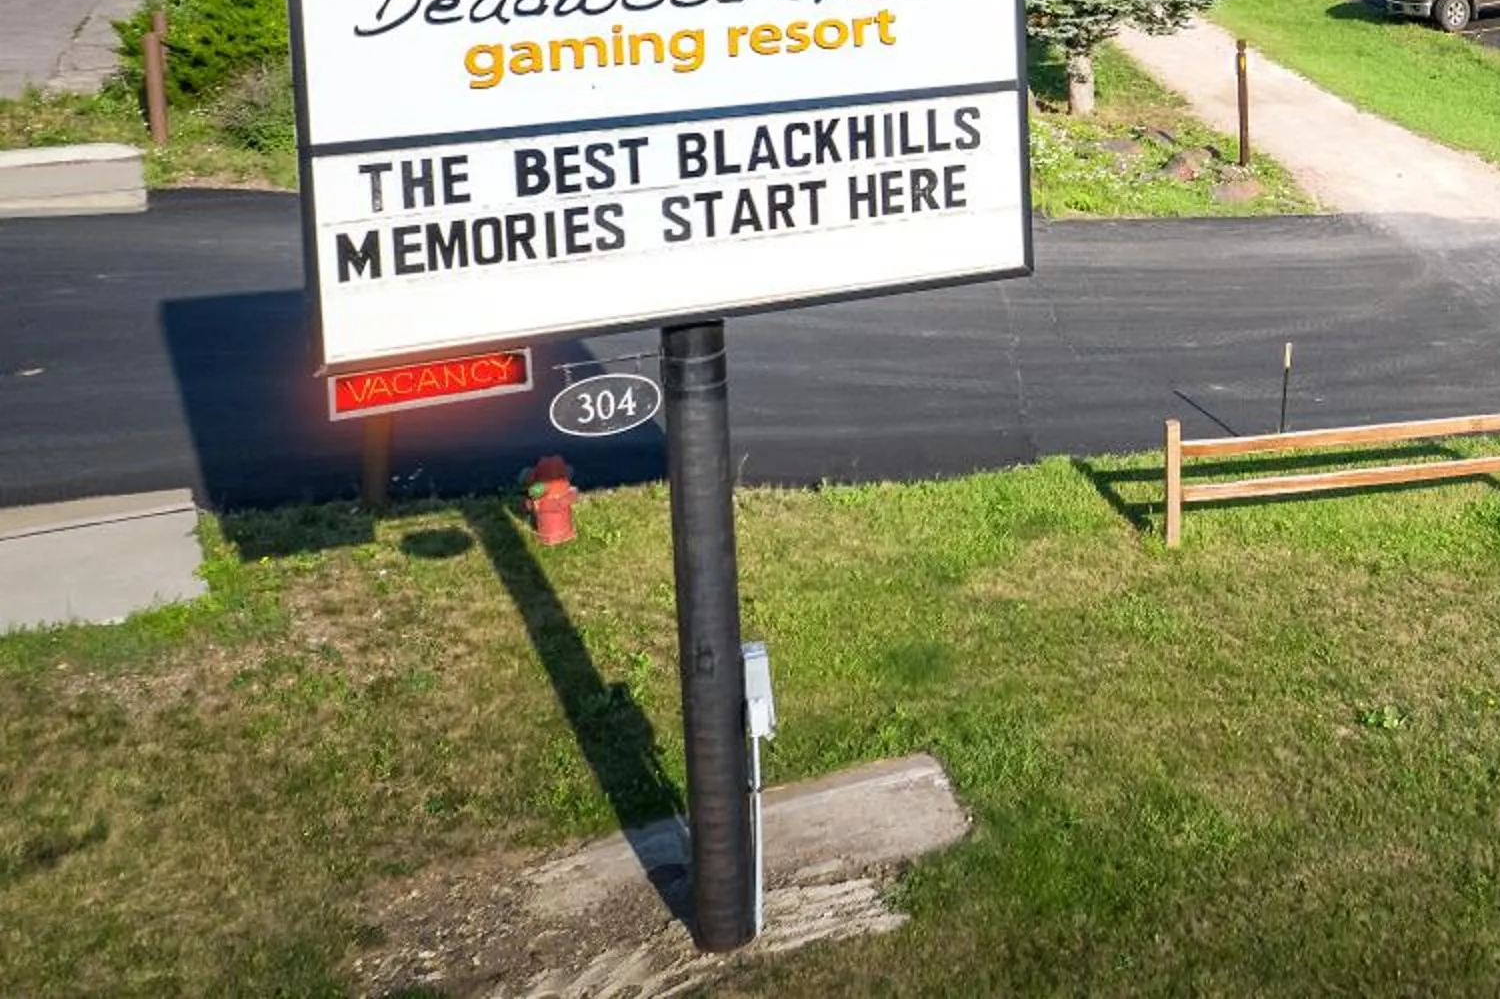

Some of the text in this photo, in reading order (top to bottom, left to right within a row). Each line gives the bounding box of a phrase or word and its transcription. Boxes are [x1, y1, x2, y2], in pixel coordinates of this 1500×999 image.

[463, 8, 897, 90] gaming resort
[358, 106, 981, 212] THE BEST BLACKHILLS
[335, 164, 967, 283] MEMORIES START HERE
[346, 356, 514, 402] VACANCY
[577, 386, 637, 424] 304
